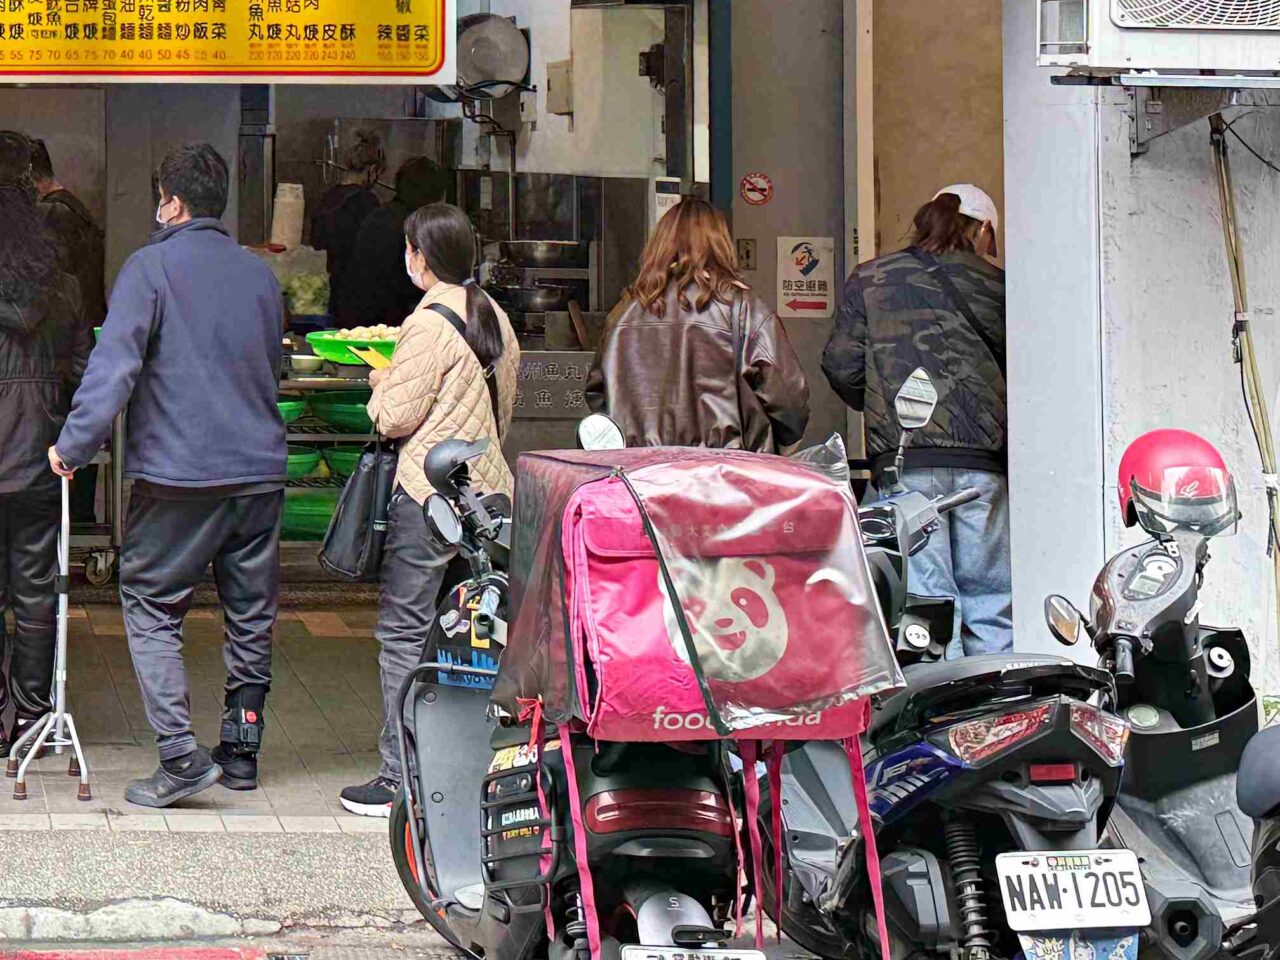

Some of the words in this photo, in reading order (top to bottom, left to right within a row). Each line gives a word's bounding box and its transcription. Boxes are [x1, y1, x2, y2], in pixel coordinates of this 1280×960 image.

[121, 49, 134, 60] 40
[158, 49, 171, 60] 50
[783, 280, 828, 291] 防空避難
